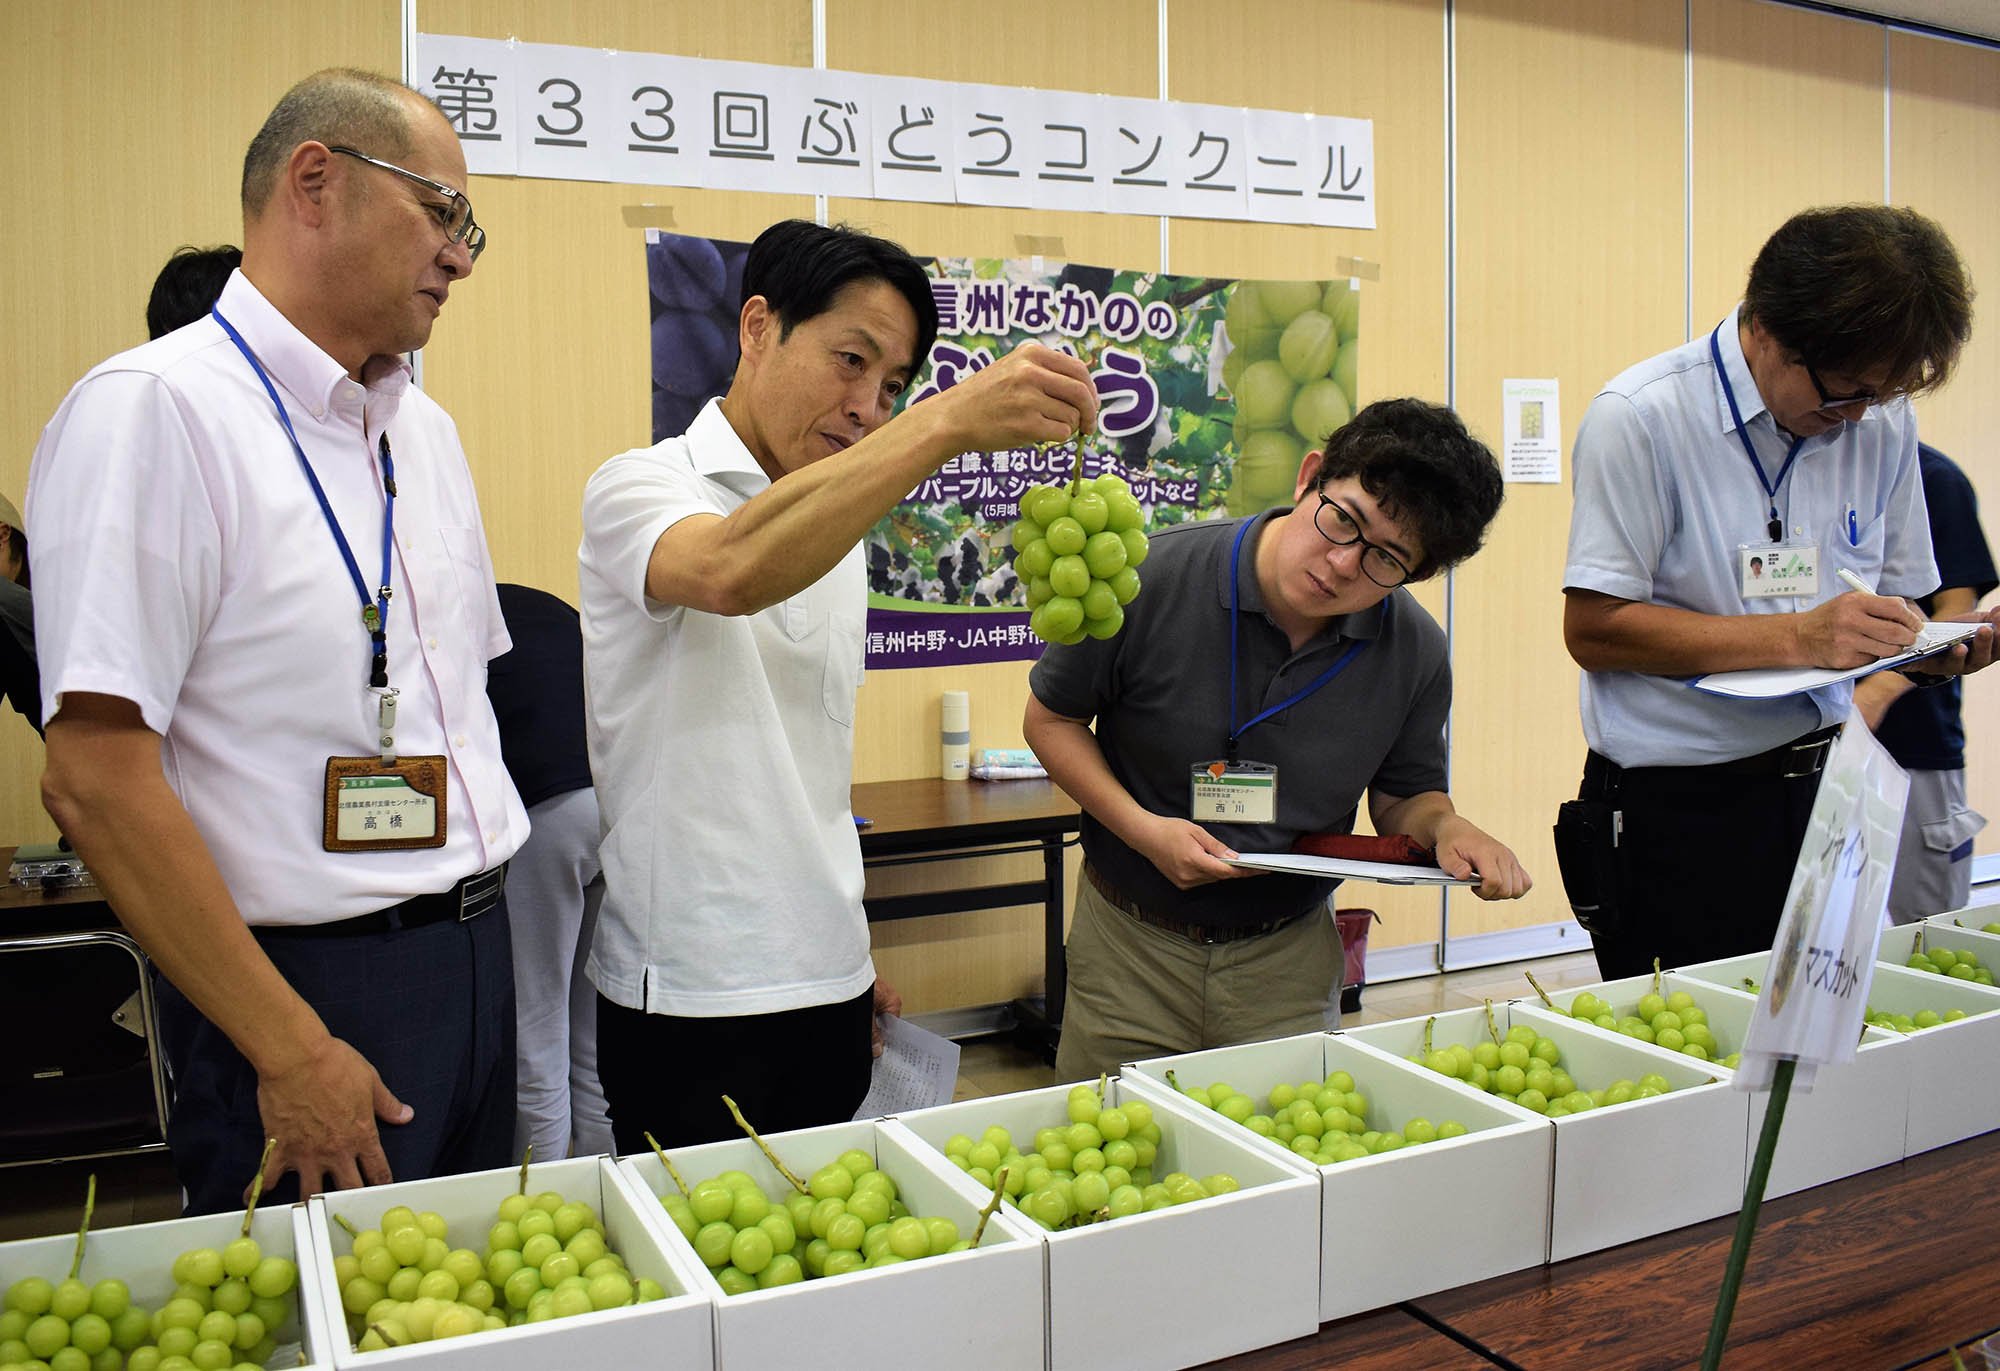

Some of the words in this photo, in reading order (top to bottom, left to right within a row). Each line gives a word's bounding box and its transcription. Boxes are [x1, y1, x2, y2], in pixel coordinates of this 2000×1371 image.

[1806, 946, 1859, 999] マスカット
